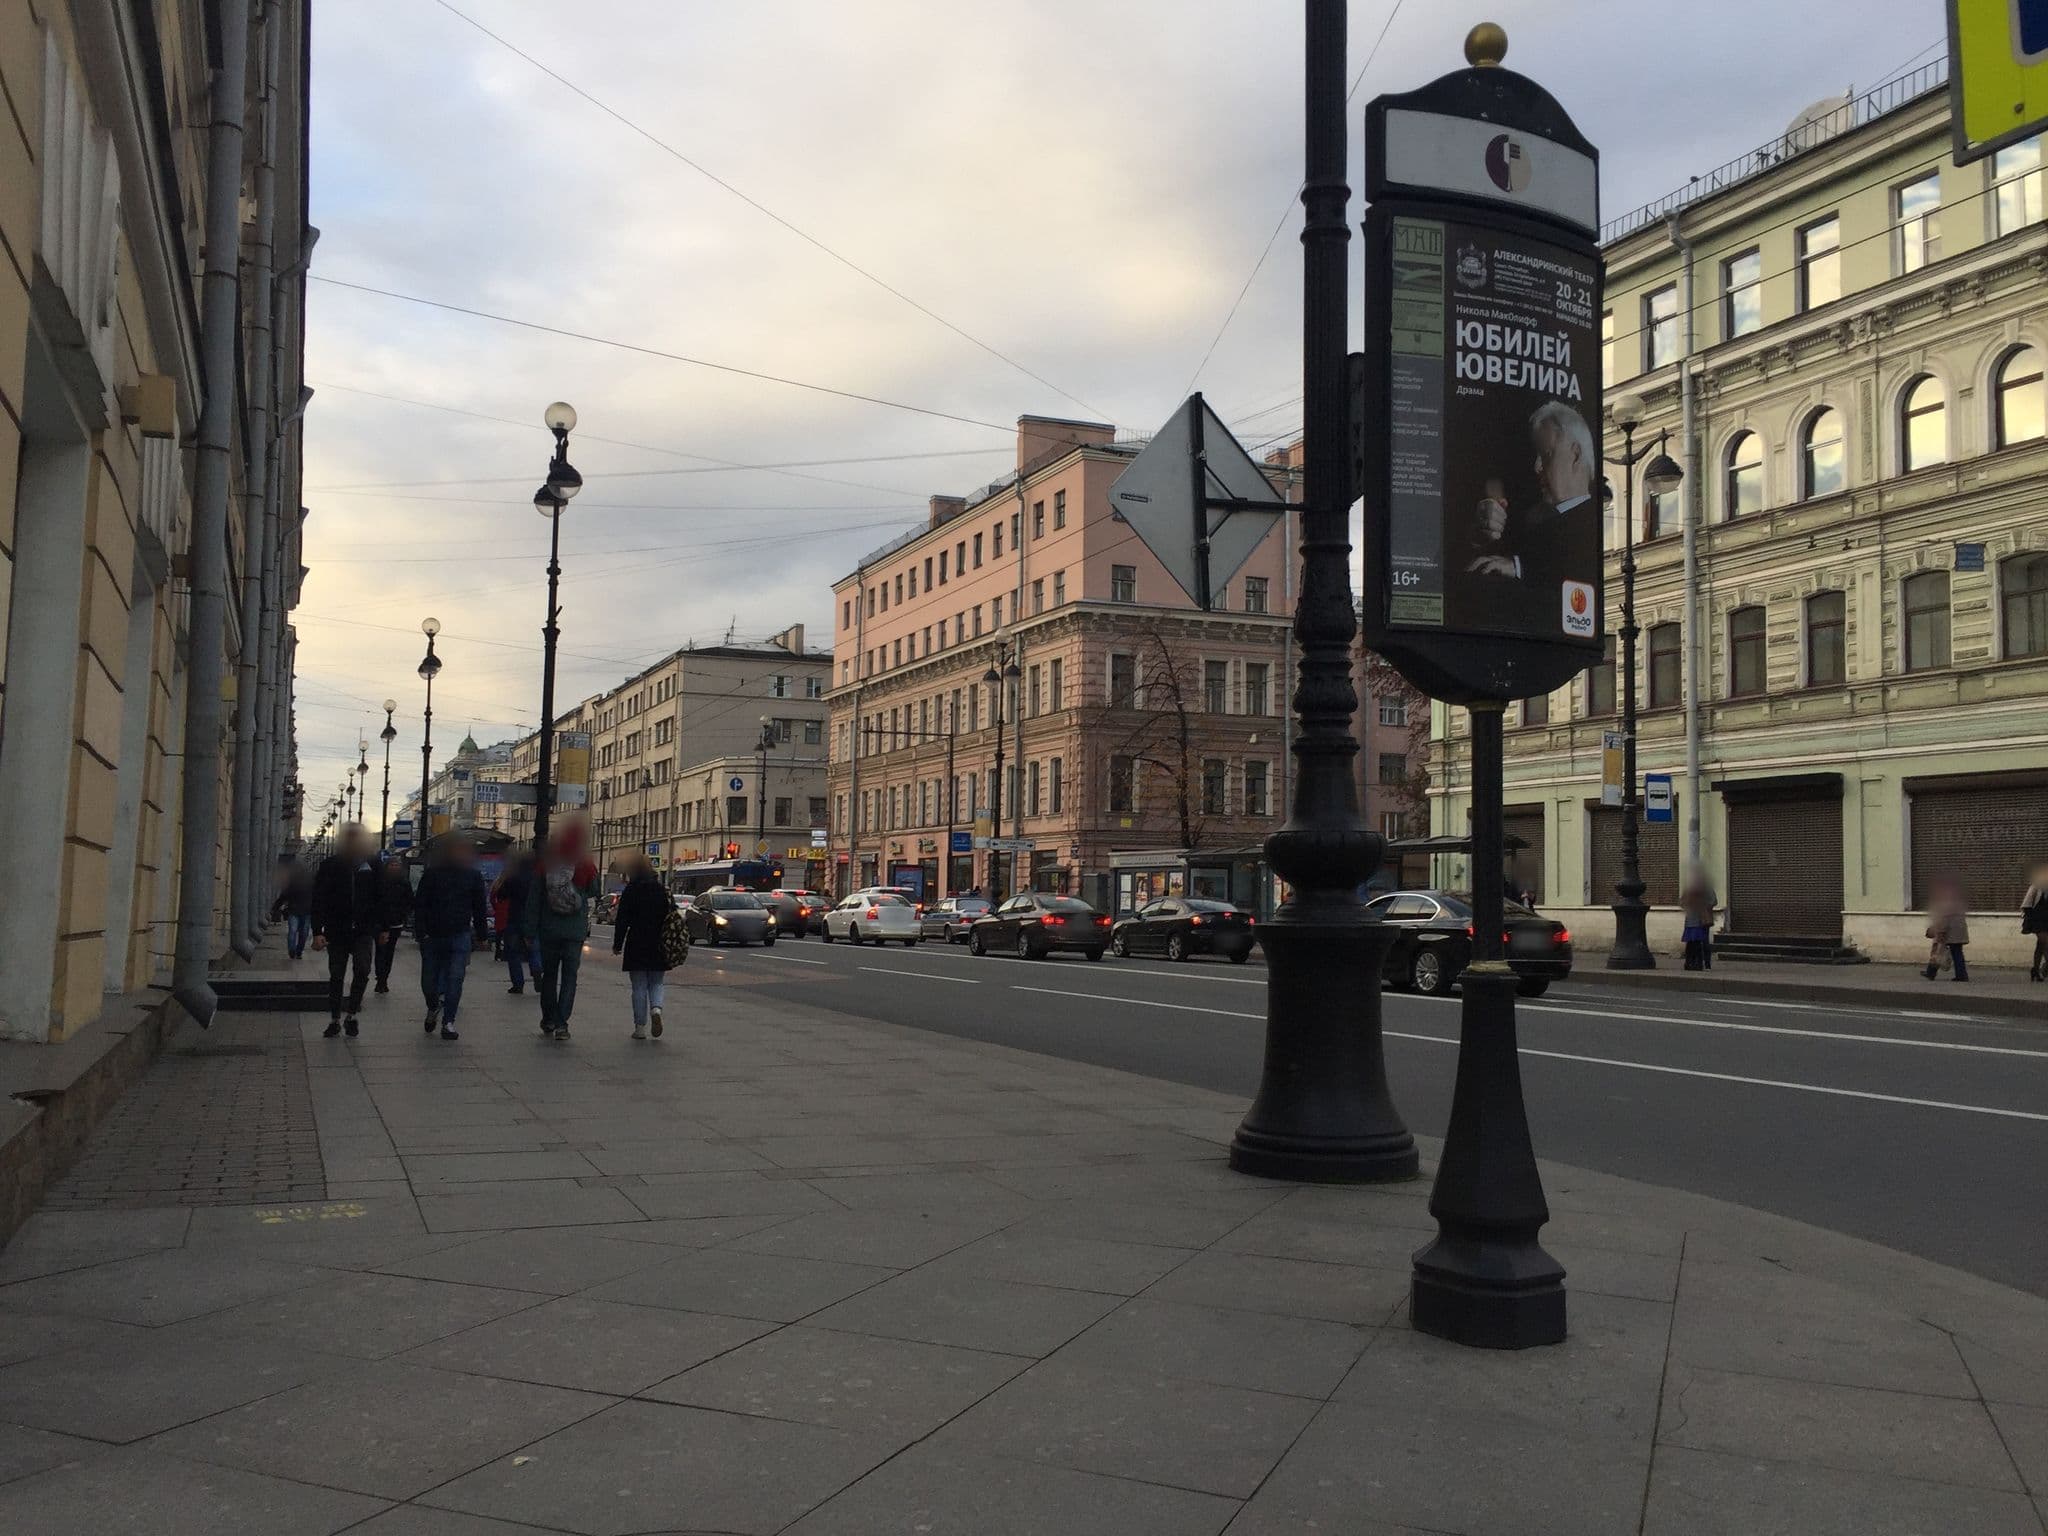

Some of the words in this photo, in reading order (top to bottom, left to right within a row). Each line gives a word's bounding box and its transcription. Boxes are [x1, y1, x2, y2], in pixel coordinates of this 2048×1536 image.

[1494, 249, 1573, 279] АЛЕКСАНДРИНСКИЙ
[1575, 270, 1594, 285] ТЕАТР
[1456, 304, 1490, 321] Никола
[1556, 299, 1592, 320] ОКТЯБРЯ
[1456, 319, 1572, 368] ЮБИЛЕЙ
[1455, 350, 1582, 401] ЮВЕЛИРА
[1456, 385, 1485, 397] Драма
[1392, 571, 1420, 586] 16+
